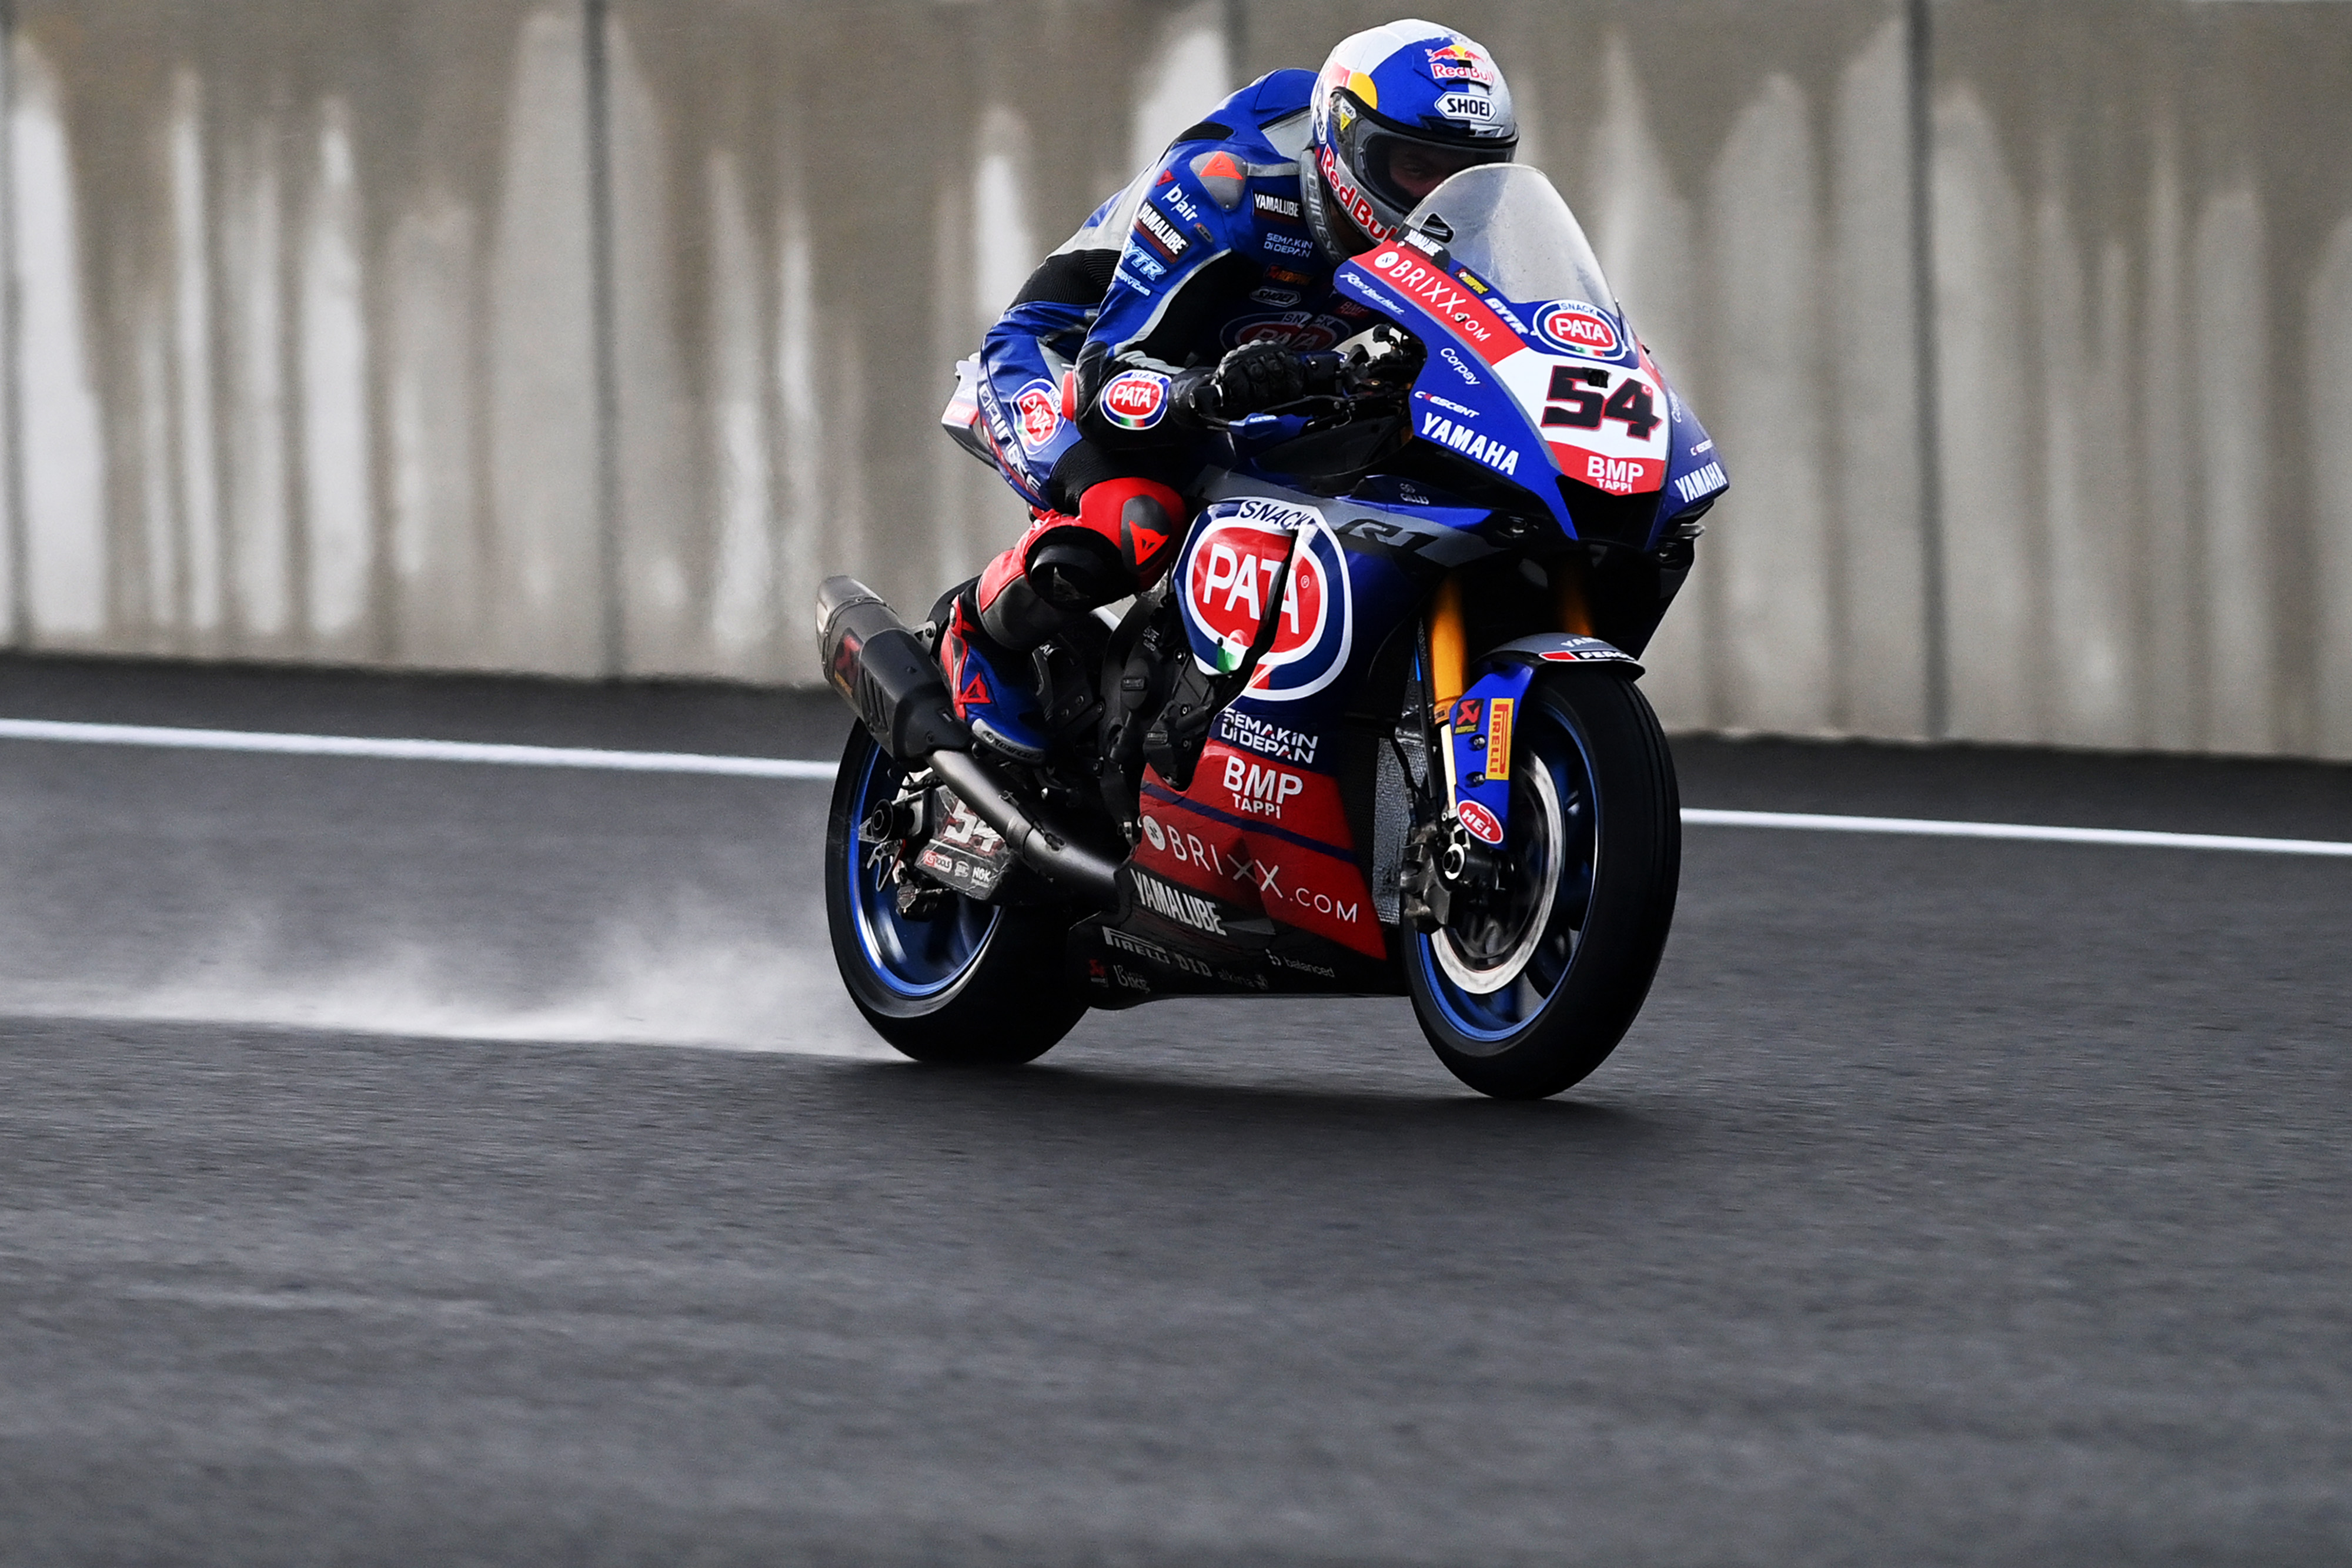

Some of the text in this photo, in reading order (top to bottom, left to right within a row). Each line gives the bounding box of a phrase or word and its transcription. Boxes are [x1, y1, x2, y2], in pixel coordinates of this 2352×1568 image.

[1432, 63, 1494, 82] Red Bull
[1447, 98, 1490, 117] SHOEI
[1255, 193, 1299, 217] YAMALUBE
[1322, 145, 1398, 242] Red Bul
[1138, 202, 1187, 255] YAMALUBE
[1124, 241, 1165, 281] YTR
[1561, 303, 1598, 317] SNACK
[1555, 317, 1609, 344] PATA
[1441, 348, 1481, 385] Corpay
[1112, 385, 1152, 409] PATA
[1541, 365, 1663, 442] 54
[1421, 412, 1519, 476] YAMAHA
[1587, 455, 1645, 484] BMP
[1596, 478, 1632, 493] TAPPI
[1674, 462, 1727, 503] YAMAHA
[1240, 501, 1311, 530] SNACK
[1239, 730, 1315, 764] DEPAN
[1490, 704, 1509, 774] PIRELLI
[1223, 755, 1303, 804] BMP
[1232, 793, 1281, 819] TAPPI
[1462, 809, 1492, 840] HEL
[973, 866, 991, 882] NGK
[1130, 868, 1227, 936] YAMALUBE
[1101, 925, 1171, 965] PIRELLI
